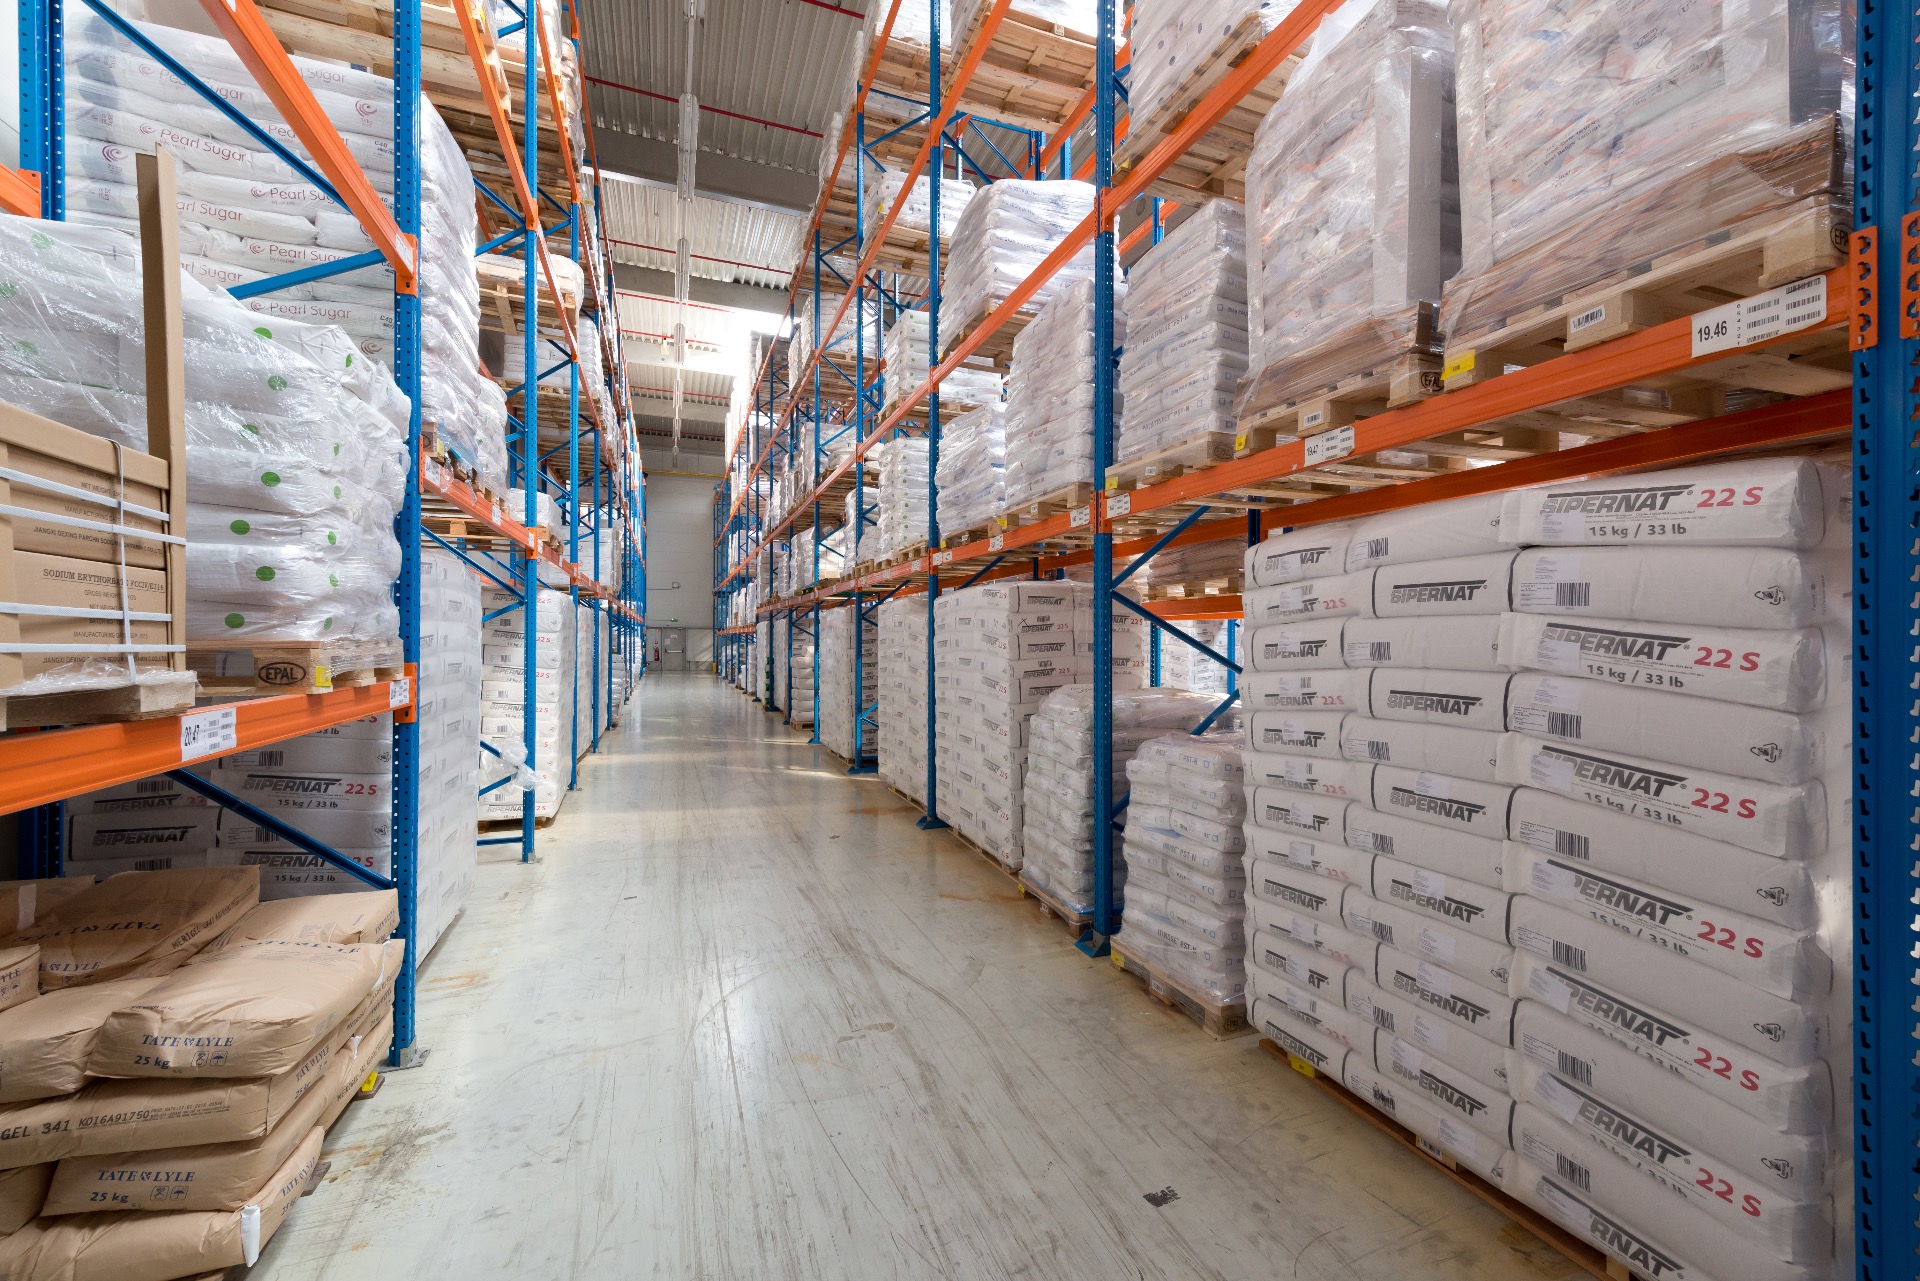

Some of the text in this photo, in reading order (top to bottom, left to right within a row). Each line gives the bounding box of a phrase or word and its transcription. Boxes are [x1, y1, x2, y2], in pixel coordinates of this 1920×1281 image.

[305, 68, 345, 83] Sugar
[160, 128, 247, 162] Pearl Sugar
[270, 188, 306, 202] Pearl
[200, 203, 245, 222] Sugar
[269, 244, 307, 260] Pearl
[199, 263, 243, 283] Sugar
[270, 302, 352, 320] Pearl Sugar
[1697, 320, 1728, 343] 19.46
[1696, 487, 1739, 508] 22
[1742, 486, 1764, 507] S
[1589, 526, 1608, 537] 15
[1612, 525, 1629, 539] kg
[1647, 525, 1667, 535] 33
[1671, 523, 1687, 535] lb
[43, 568, 75, 580] SODIUM
[84, 589, 102, 597] GROSS
[1390, 580, 1487, 604] SIPERNAT
[1322, 598, 1347, 610] 22 S
[1693, 646, 1732, 669] 22
[1739, 651, 1761, 672] S
[265, 667, 299, 681] EPAL
[1586, 664, 1605, 676] 15
[1609, 666, 1626, 683] kg
[1644, 672, 1664, 685] 33
[1669, 673, 1684, 688] lb
[1322, 695, 1336, 706] 22
[1337, 695, 1345, 705] S
[1387, 690, 1482, 716] SIPERNAT
[242, 774, 377, 795] SIPERNAT 22 S
[1322, 784, 1338, 794] 22
[1337, 785, 1347, 796] S
[278, 799, 290, 807] 15
[292, 799, 304, 809] kg
[1584, 792, 1603, 804] 15
[1606, 796, 1625, 813] kg
[1643, 807, 1662, 820] 33
[1668, 811, 1683, 825] lb
[1691, 788, 1731, 814] 22
[1737, 799, 1757, 819] S
[92, 826, 197, 846] SIPERNAT
[290, 875, 301, 883] kg
[1324, 867, 1339, 878] 22
[1589, 911, 1608, 925] 15
[1613, 917, 1631, 936] kg
[1649, 933, 1669, 948] 33
[1673, 939, 1689, 956] lb
[1697, 921, 1736, 951] 22
[1743, 937, 1764, 959] S
[141, 1034, 235, 1047] TATE LYLE
[134, 1055, 171, 1070] 25 kg
[1693, 1047, 1732, 1080] 22
[1740, 1069, 1760, 1092] S
[41, 1119, 71, 1135] 341
[98, 1170, 196, 1182] TATE LYLE
[90, 1192, 129, 1204] 25 kg
[1696, 1168, 1734, 1204] 22
[1741, 1194, 1762, 1218] S
